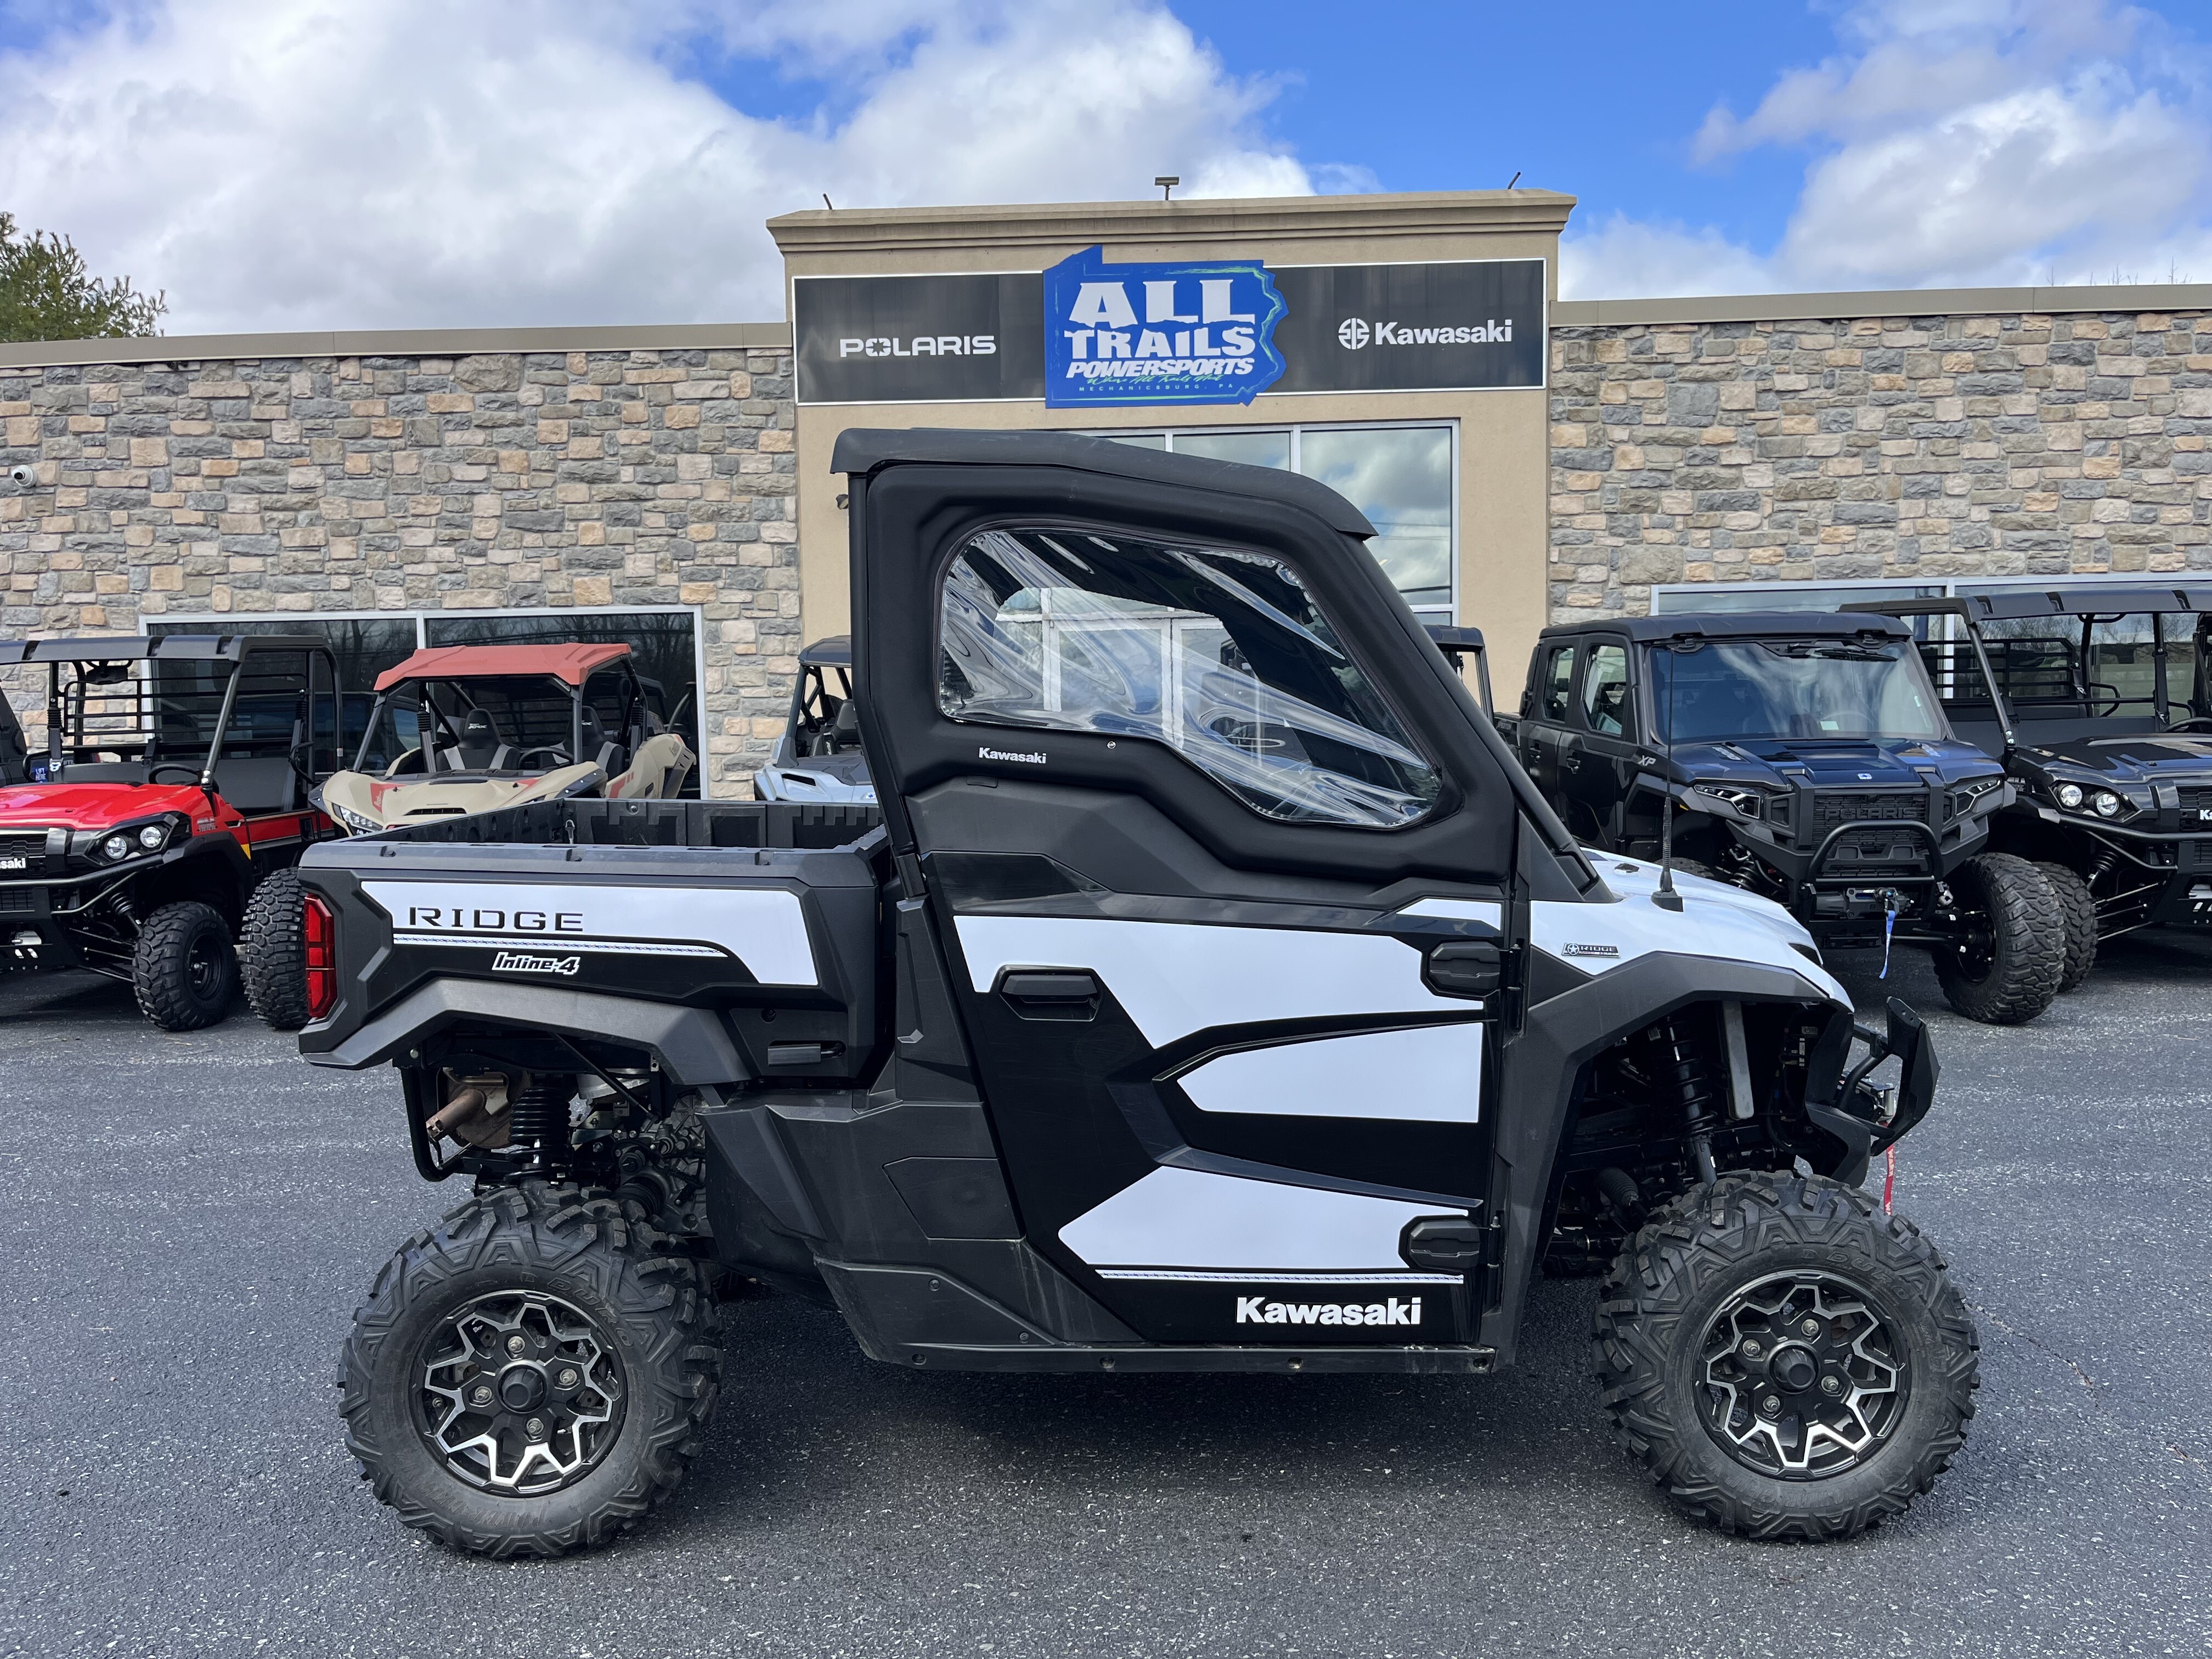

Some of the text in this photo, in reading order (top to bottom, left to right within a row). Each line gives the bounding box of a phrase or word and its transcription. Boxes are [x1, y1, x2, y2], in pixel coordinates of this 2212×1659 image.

[1069, 279, 1255, 329] ALL
[1064, 326, 1256, 359] TRAILS
[1375, 319, 1513, 345] Kawasaki
[839, 335, 997, 357] POLARIS
[1065, 358, 1255, 379] POWERSPORTS
[1129, 374, 1156, 384] All
[979, 747, 1047, 764] Kawasaki
[1638, 755, 1657, 766] XP
[1825, 807, 1918, 820] POLARIS
[0, 857, 26, 870] saki
[409, 907, 584, 932] RIDGE
[492, 951, 581, 975] Inline-4
[1826, 1250, 1911, 1300] DURO
[548, 1277, 633, 1347] DURO
[1236, 1296, 1421, 1325] Kawasaki
